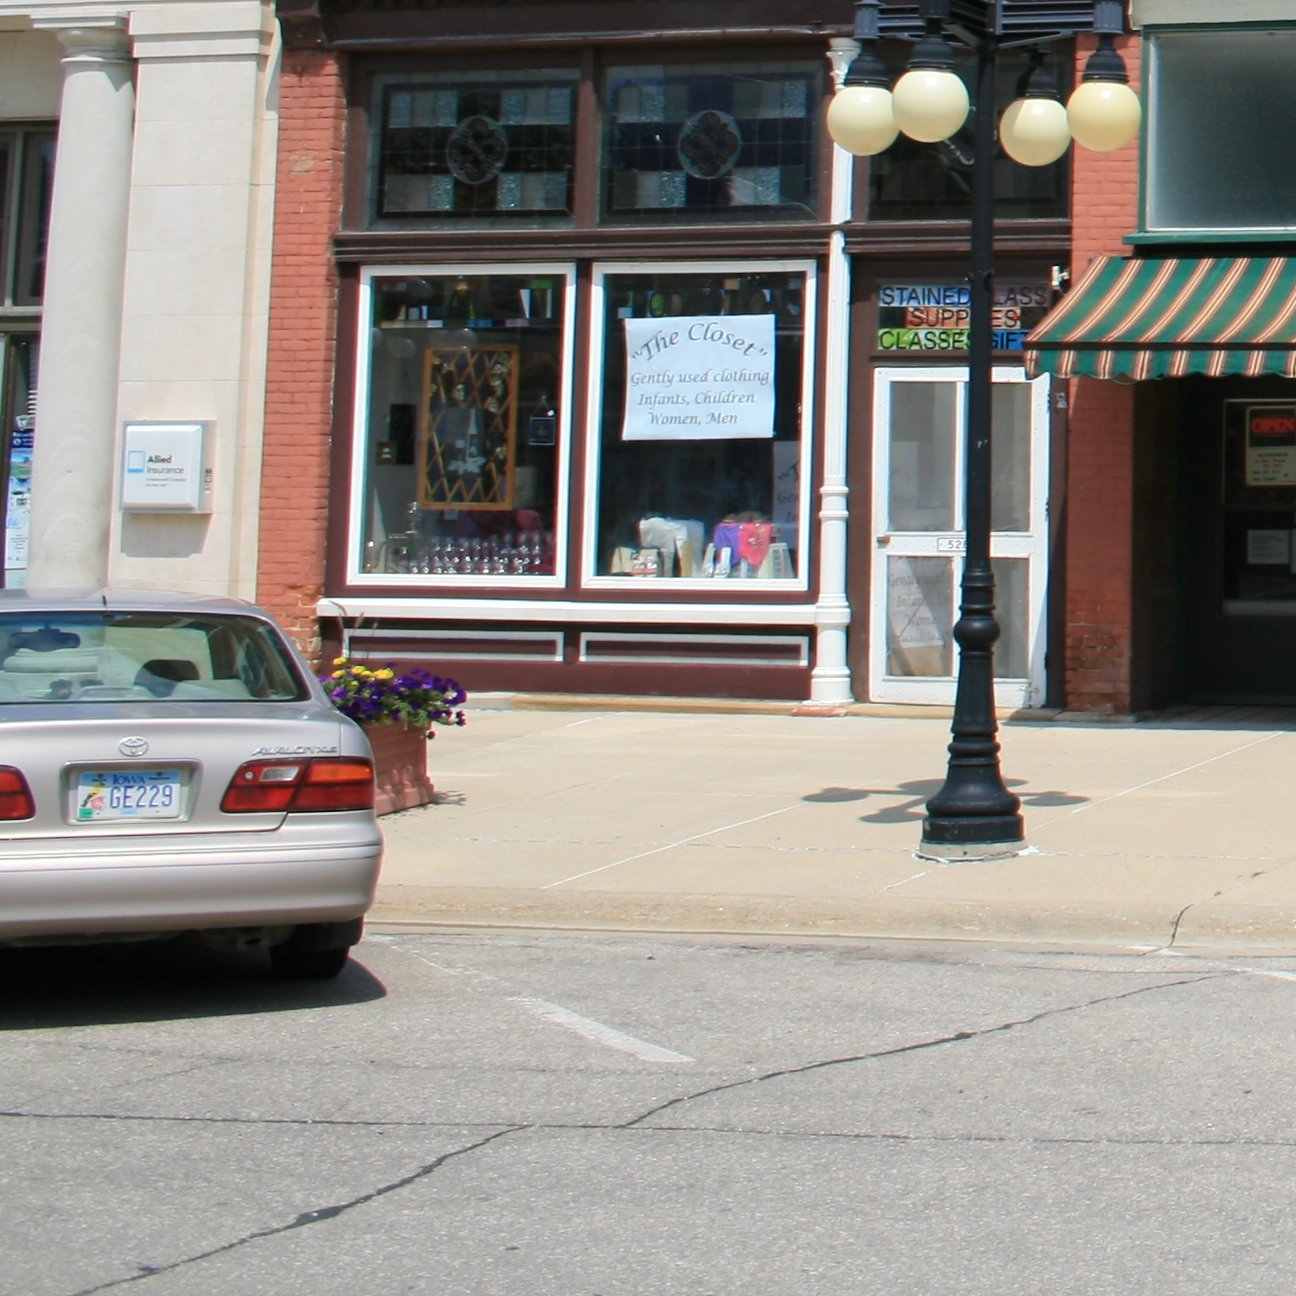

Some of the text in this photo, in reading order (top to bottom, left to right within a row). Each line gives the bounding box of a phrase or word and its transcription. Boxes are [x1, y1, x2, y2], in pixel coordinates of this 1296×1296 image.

[880, 286, 971, 306] STAINED
[631, 368, 770, 387] Gently used clothing
[637, 391, 756, 409] Infants, Children
[649, 412, 739, 425] Women, Men
[1251, 417, 1296, 435] OPEN
[147, 455, 173, 464] Allied
[146, 465, 184, 474] Insurance
[110, 785, 173, 810] GE229
